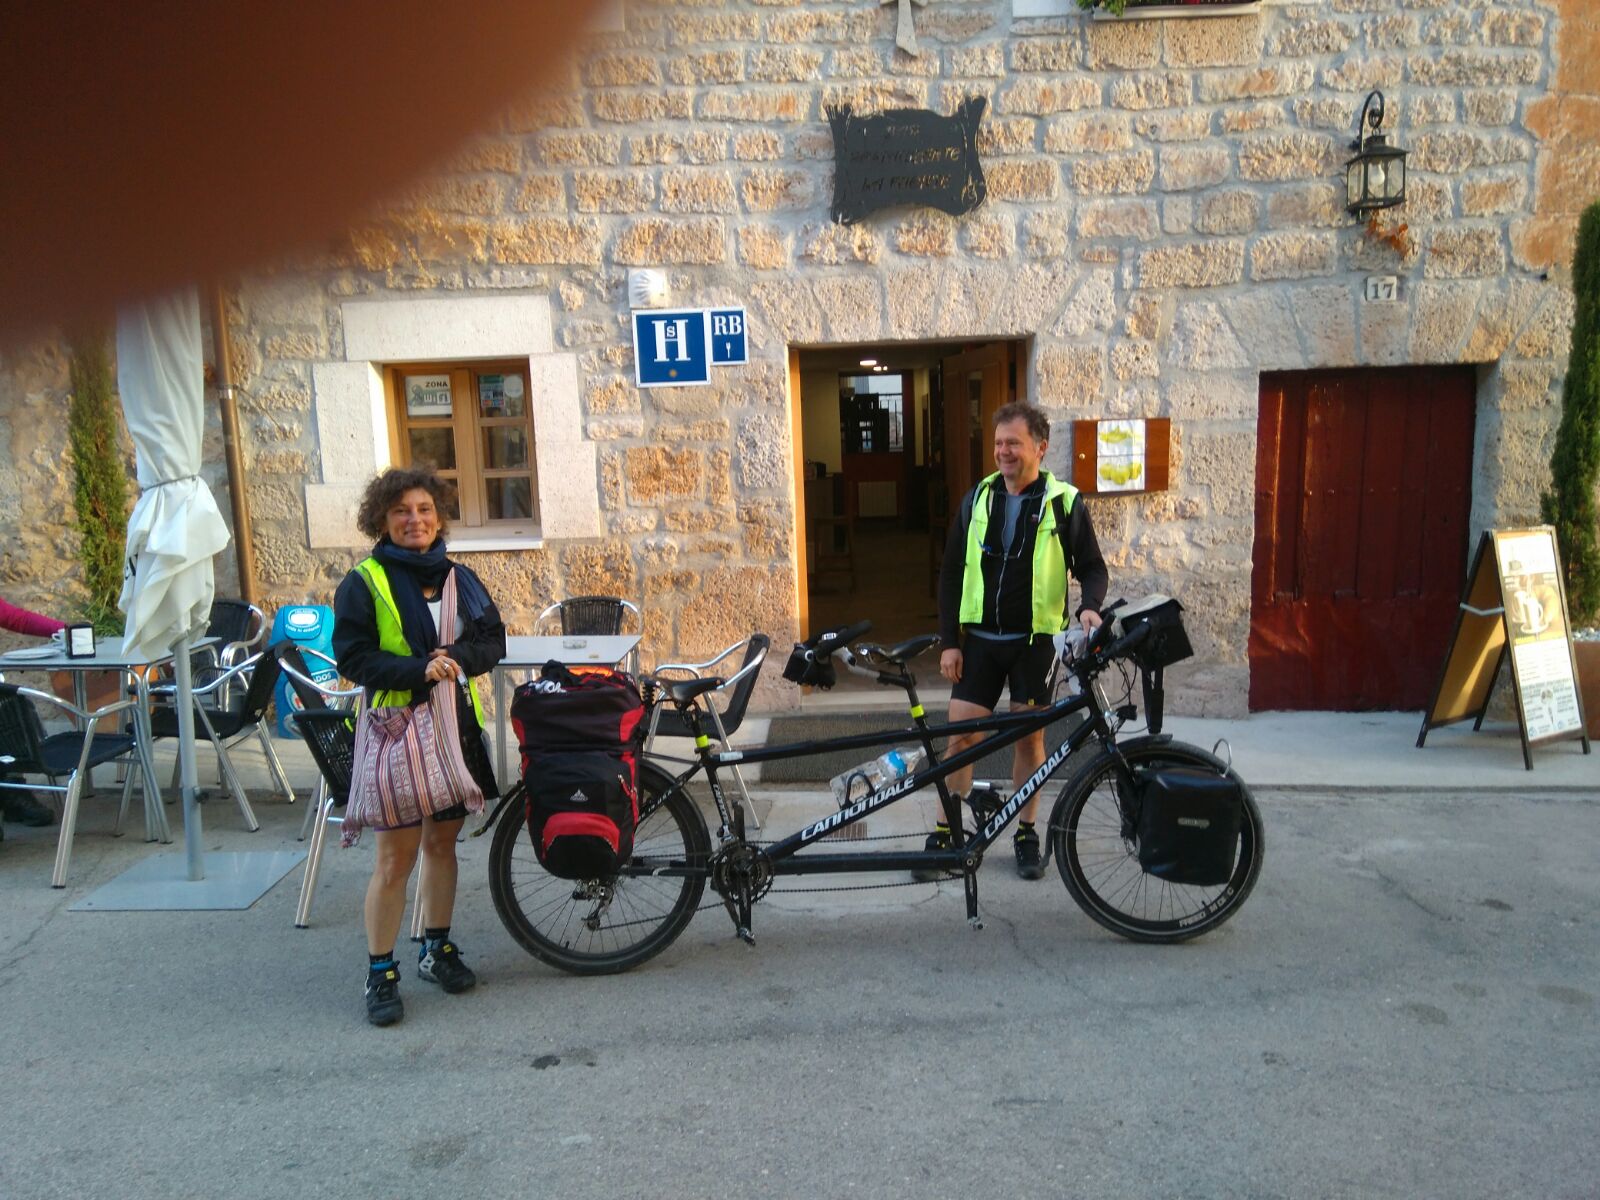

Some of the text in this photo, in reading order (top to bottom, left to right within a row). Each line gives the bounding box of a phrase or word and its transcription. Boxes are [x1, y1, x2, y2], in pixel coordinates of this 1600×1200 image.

[1371, 283, 1394, 299] 17
[713, 315, 742, 336] RB
[801, 775, 915, 841] CANNONDALE
[984, 740, 1071, 839] CANNONDALE
